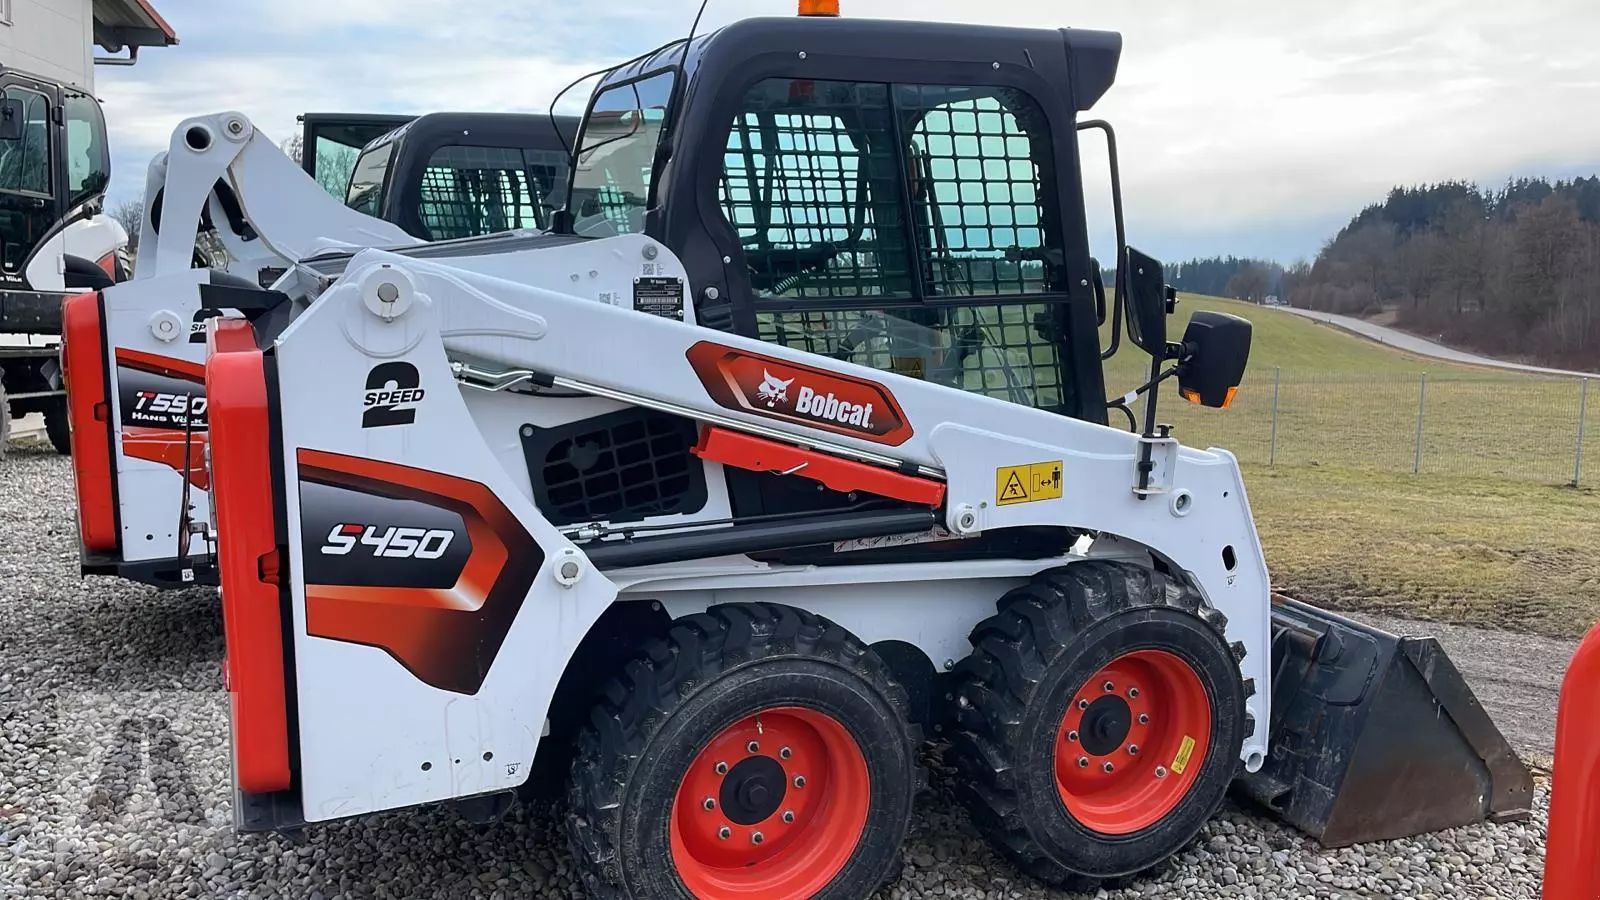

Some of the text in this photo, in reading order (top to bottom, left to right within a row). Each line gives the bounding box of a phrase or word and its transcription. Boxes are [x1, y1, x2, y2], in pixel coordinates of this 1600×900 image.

[136, 391, 207, 414] T590
[362, 361, 420, 428] 2
[363, 389, 425, 406] SPEED
[795, 386, 874, 429] Bobcat
[320, 524, 455, 560] S450
